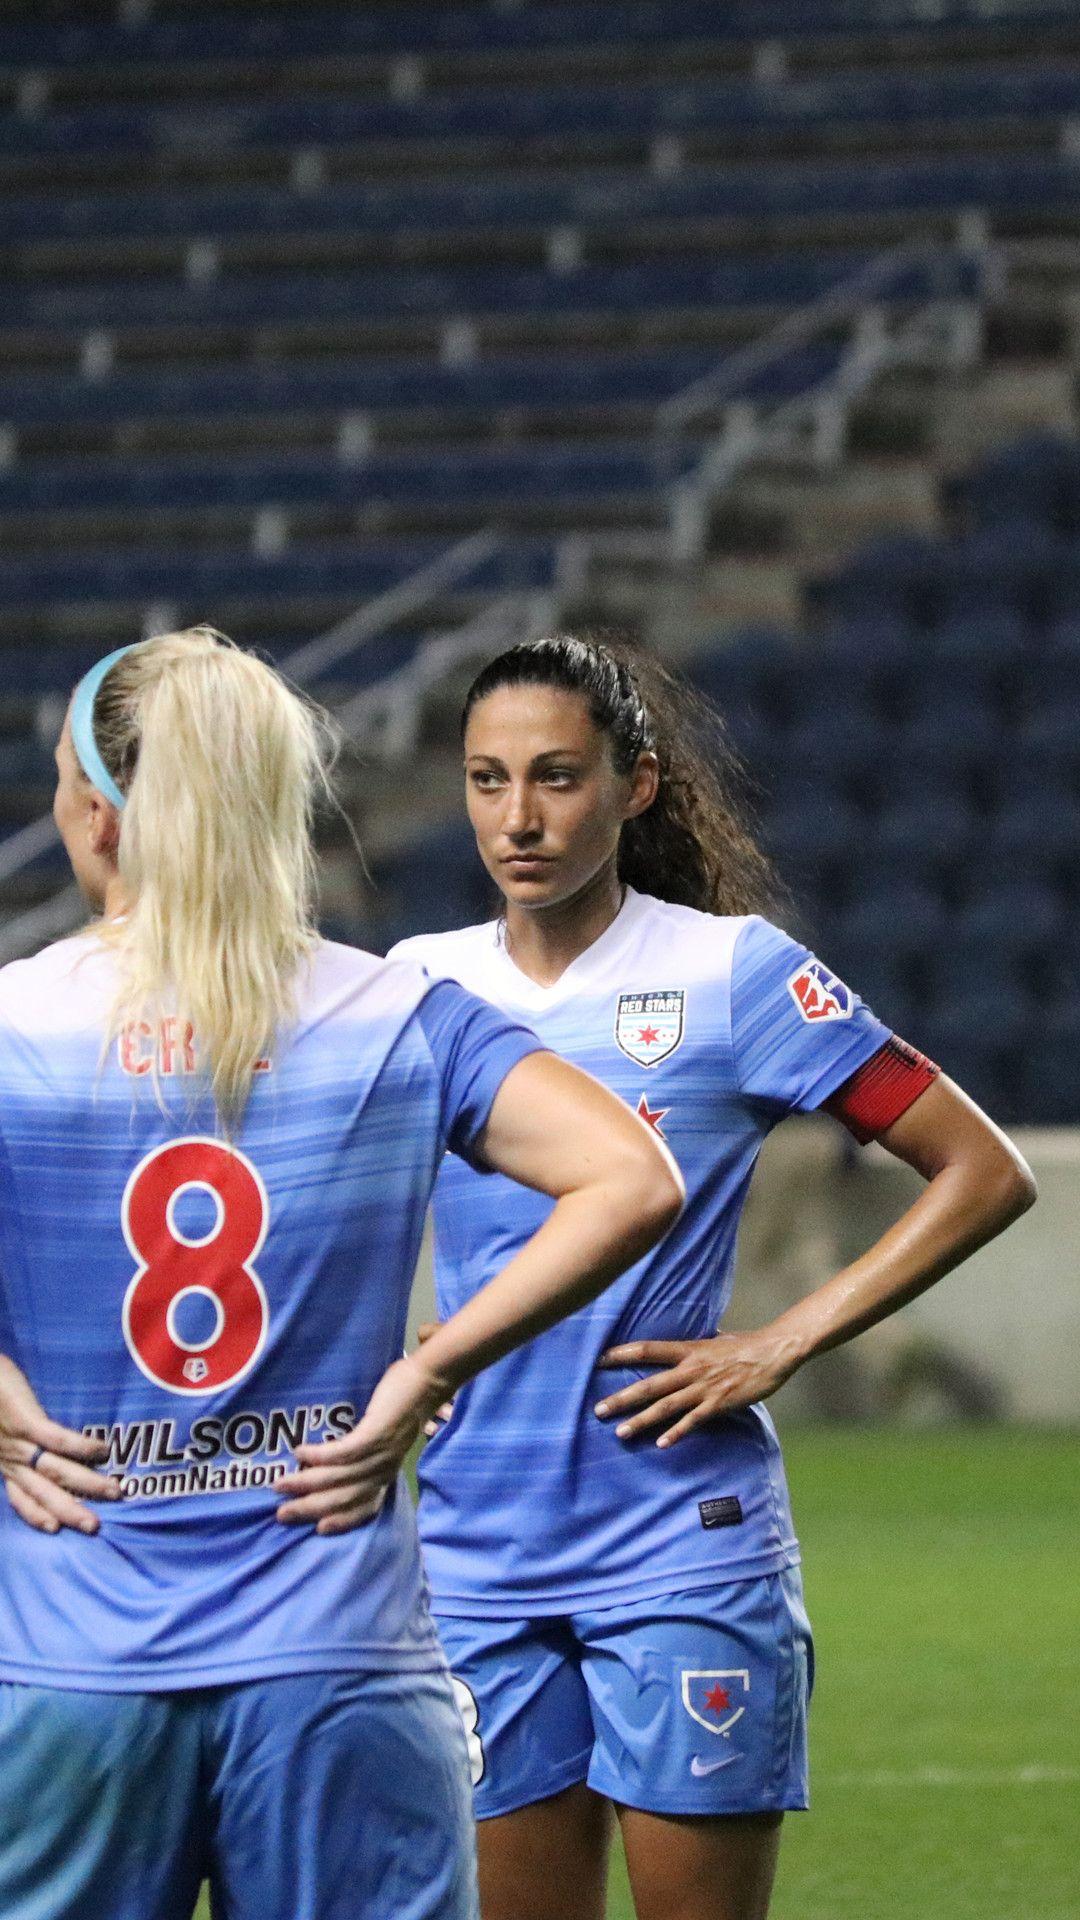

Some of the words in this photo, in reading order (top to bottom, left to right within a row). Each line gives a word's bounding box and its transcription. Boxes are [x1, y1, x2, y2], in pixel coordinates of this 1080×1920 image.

[620, 1000, 643, 1013] RED
[645, 998, 681, 1012] STARS
[121, 1136, 270, 1397] 8
